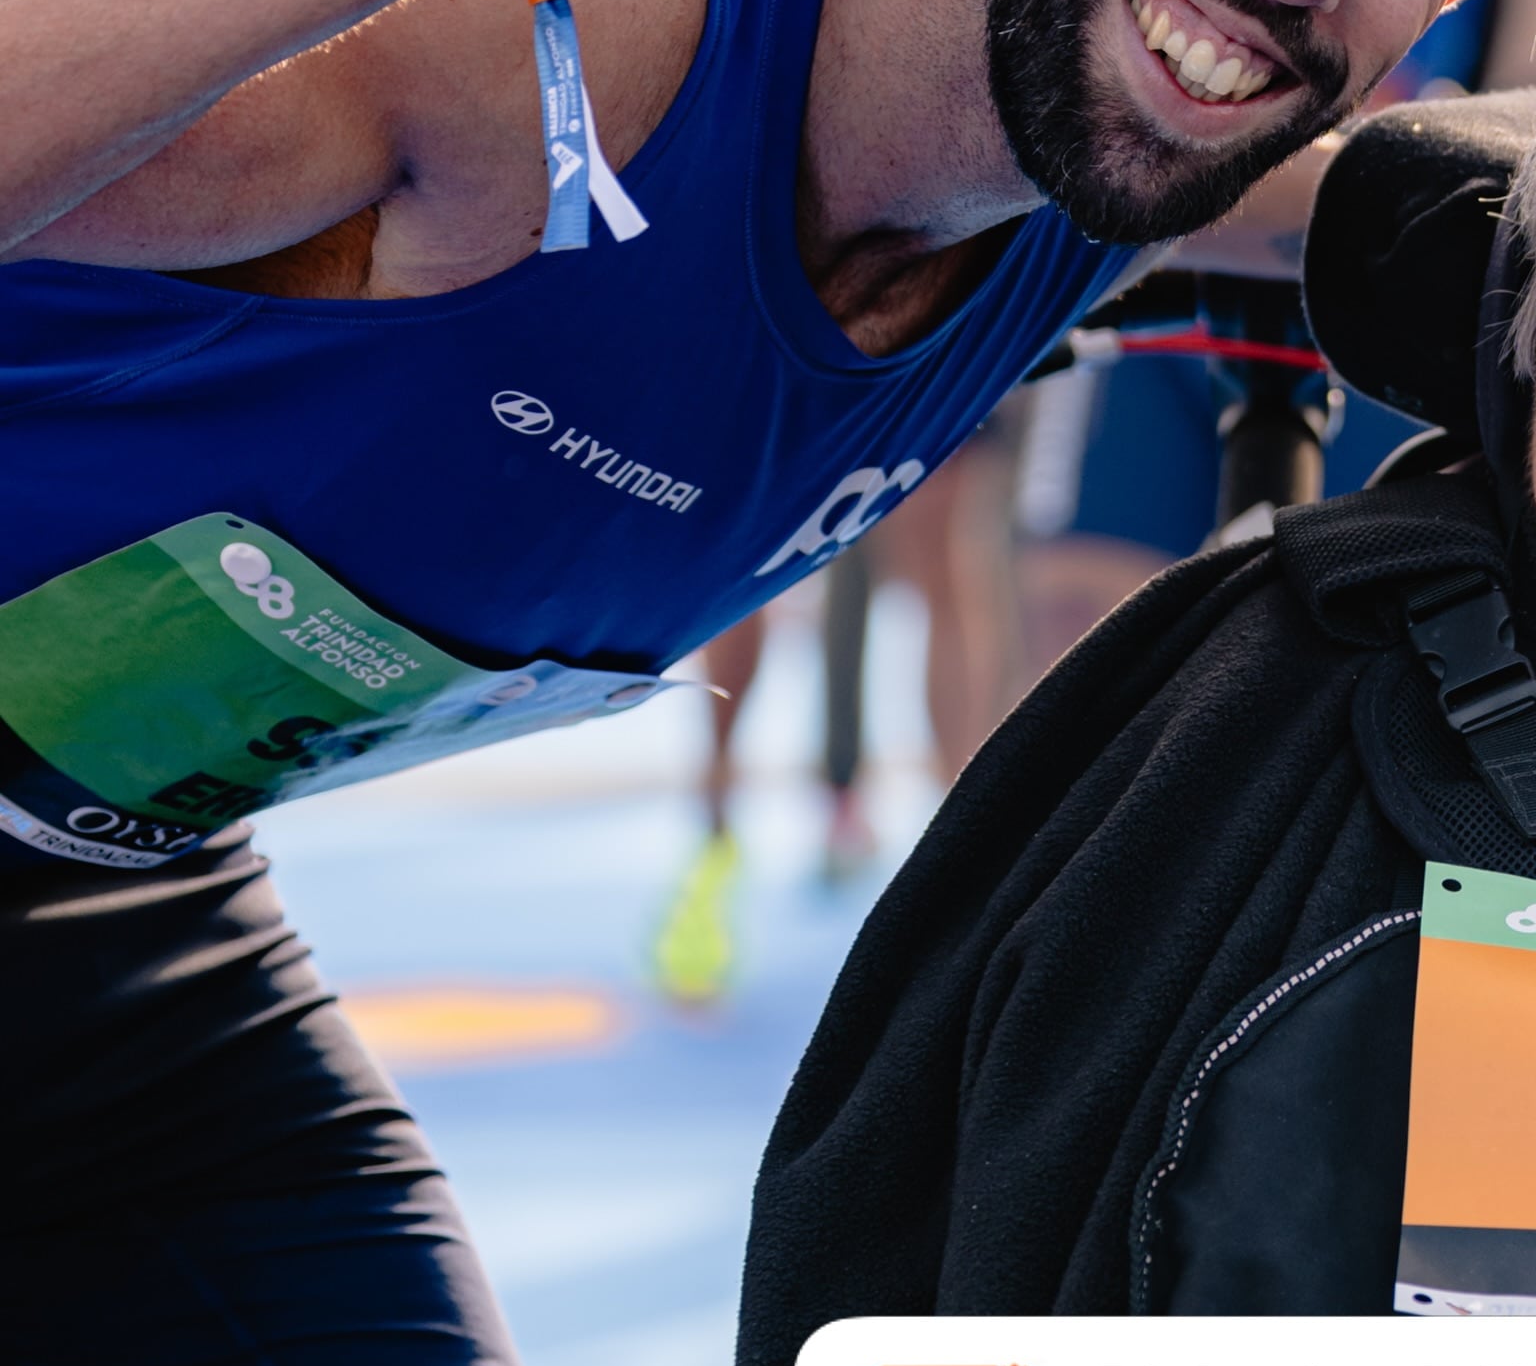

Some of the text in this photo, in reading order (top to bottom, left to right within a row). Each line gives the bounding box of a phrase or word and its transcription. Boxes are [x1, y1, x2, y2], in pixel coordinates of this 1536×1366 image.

[548, 427, 703, 514] HYUNDAI
[280, 628, 388, 690] ALFONSO
[301, 614, 405, 679] TRINIDAD
[318, 608, 422, 670] FUNDACIÓN
